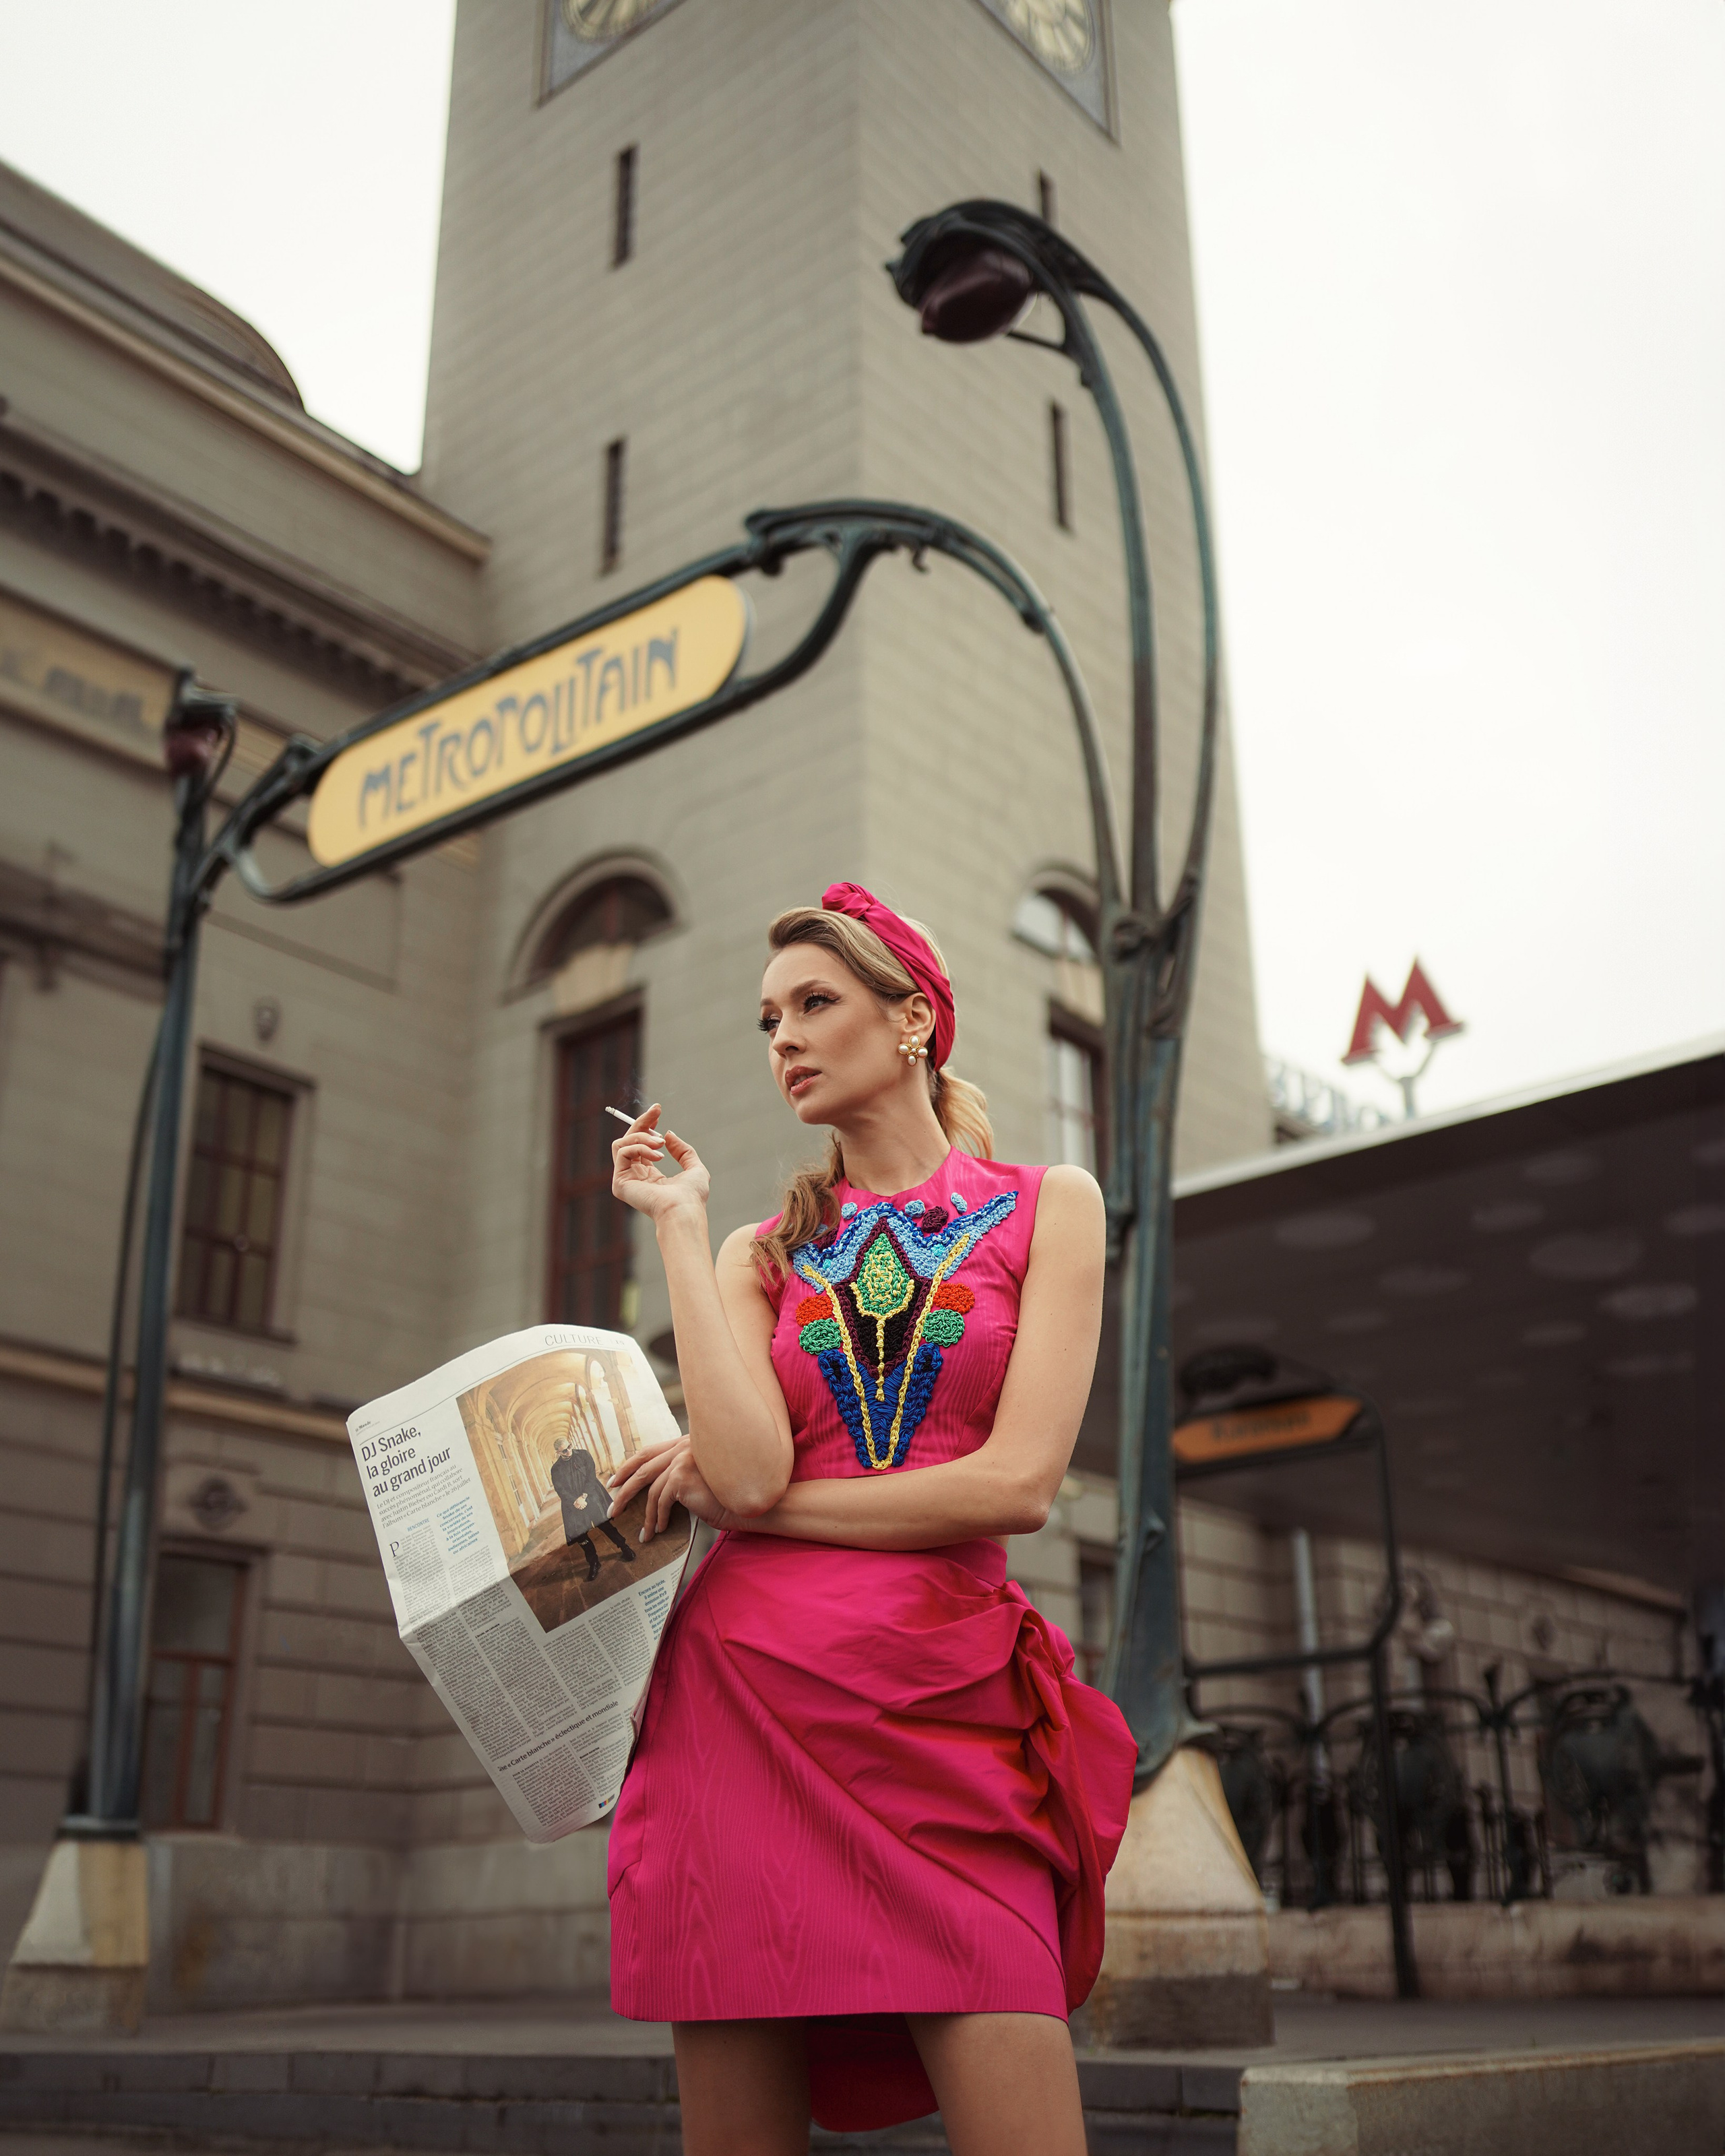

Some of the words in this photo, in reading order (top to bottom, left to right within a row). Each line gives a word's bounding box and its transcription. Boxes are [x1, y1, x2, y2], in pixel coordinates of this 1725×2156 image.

[358, 628, 681, 831] METROPOLITAIN
[544, 1333, 604, 1346] CULTURE
[361, 1442, 377, 1461] DJ
[378, 1427, 420, 1452] Snake,
[366, 1465, 379, 1480] la
[381, 1448, 416, 1476] gloire
[373, 1481, 388, 1497] au
[390, 1459, 427, 1492] grand
[427, 1447, 450, 1473] jour
[379, 1504, 396, 1515] succès
[396, 1486, 431, 1508] phénoménal,
[431, 1480, 440, 1490] qui
[440, 1468, 462, 1484] collabore
[396, 1480, 429, 1499] compositeur
[430, 1469, 449, 1482] français
[381, 1513, 392, 1522] avec
[392, 1505, 408, 1516] Justin
[408, 1496, 425, 1508] Bieber
[433, 1484, 447, 1495] Cardi
[452, 1476, 462, 1484] sort
[382, 1515, 403, 1529] l'album
[406, 1507, 421, 1516] Carte
[421, 1496, 442, 1509] blanche
[457, 1478, 470, 1490] juillet
[407, 1517, 431, 1532] RENCONTRE
[638, 1587, 651, 1596] Encore
[510, 1754, 528, 1765] Carte
[526, 1740, 551, 1756] blanche
[555, 1719, 586, 1740] éclectique
[592, 1701, 618, 1718] mondiale
